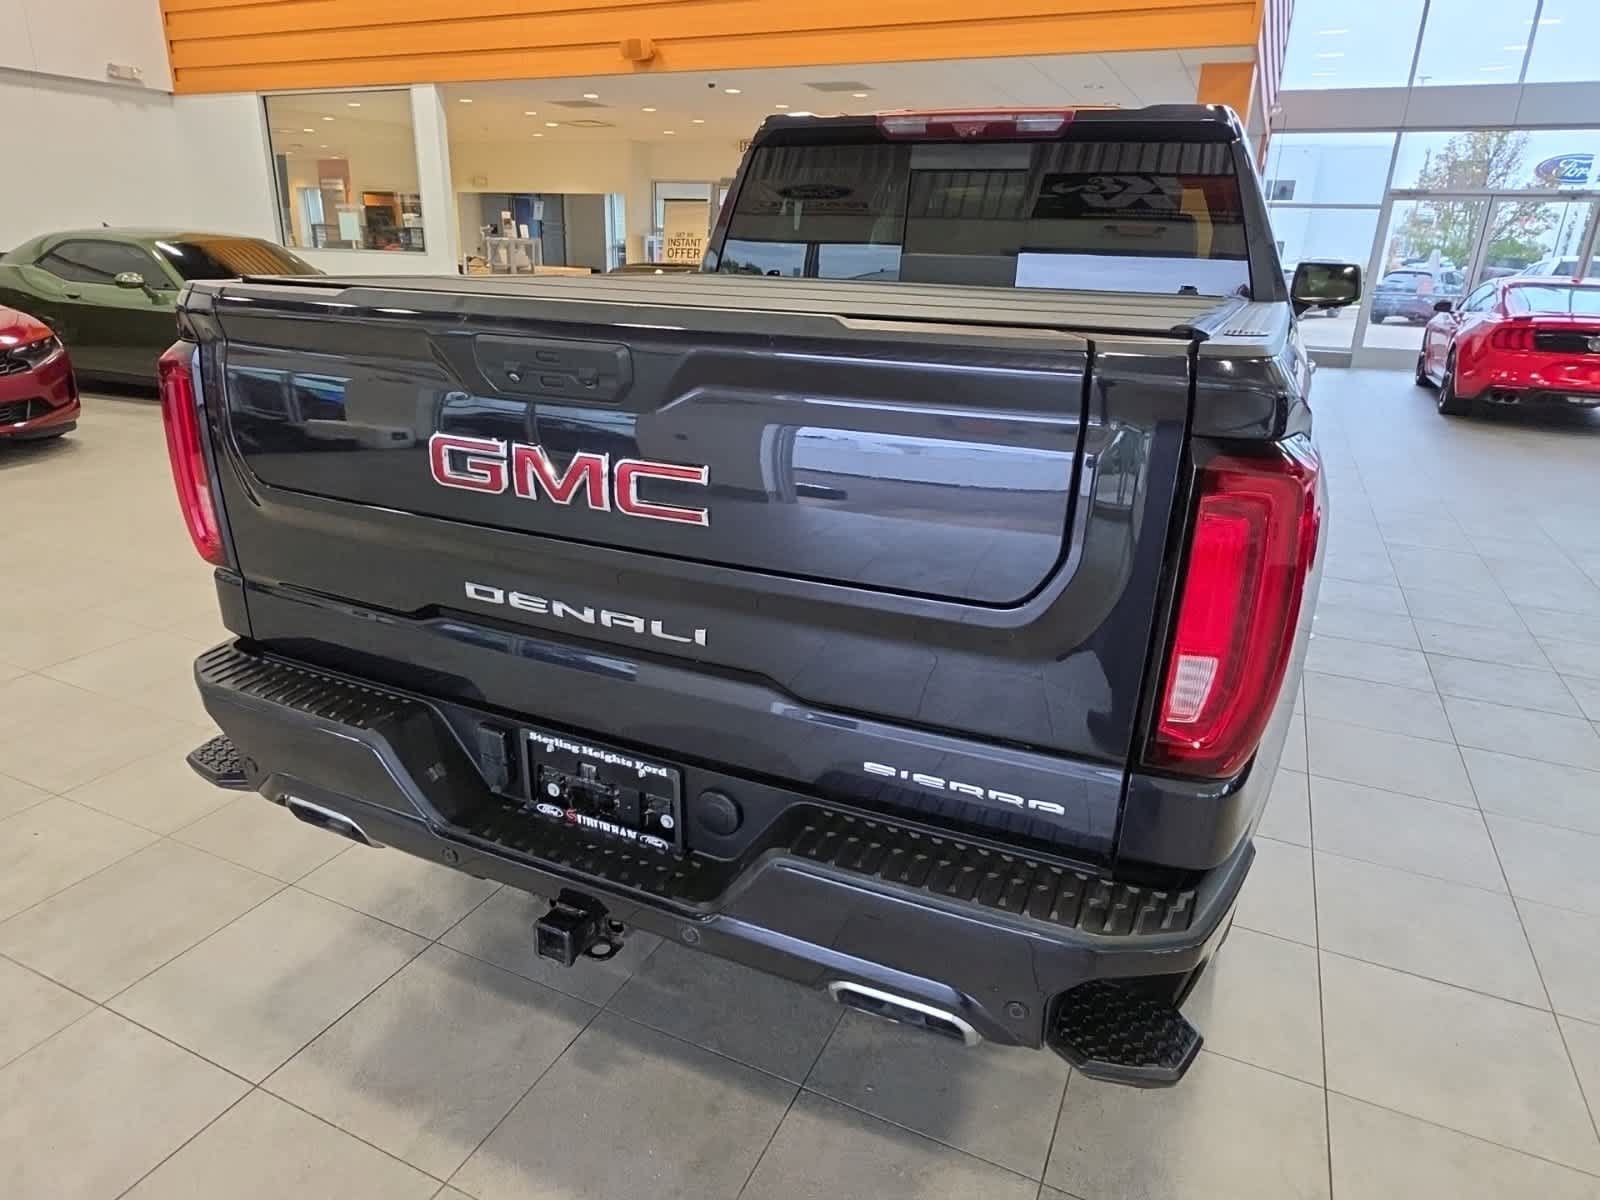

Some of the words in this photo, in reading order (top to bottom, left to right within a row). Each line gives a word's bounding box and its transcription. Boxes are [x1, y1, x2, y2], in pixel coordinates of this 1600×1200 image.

[667, 238, 702, 248] INSTANT
[667, 247, 701, 259] OFFER
[429, 431, 710, 527] GMC
[464, 581, 706, 647] DENALI
[528, 731, 580, 754] Sterling
[581, 745, 634, 768] Heights
[634, 759, 668, 777] Ford
[863, 761, 1065, 816] SIERRA
